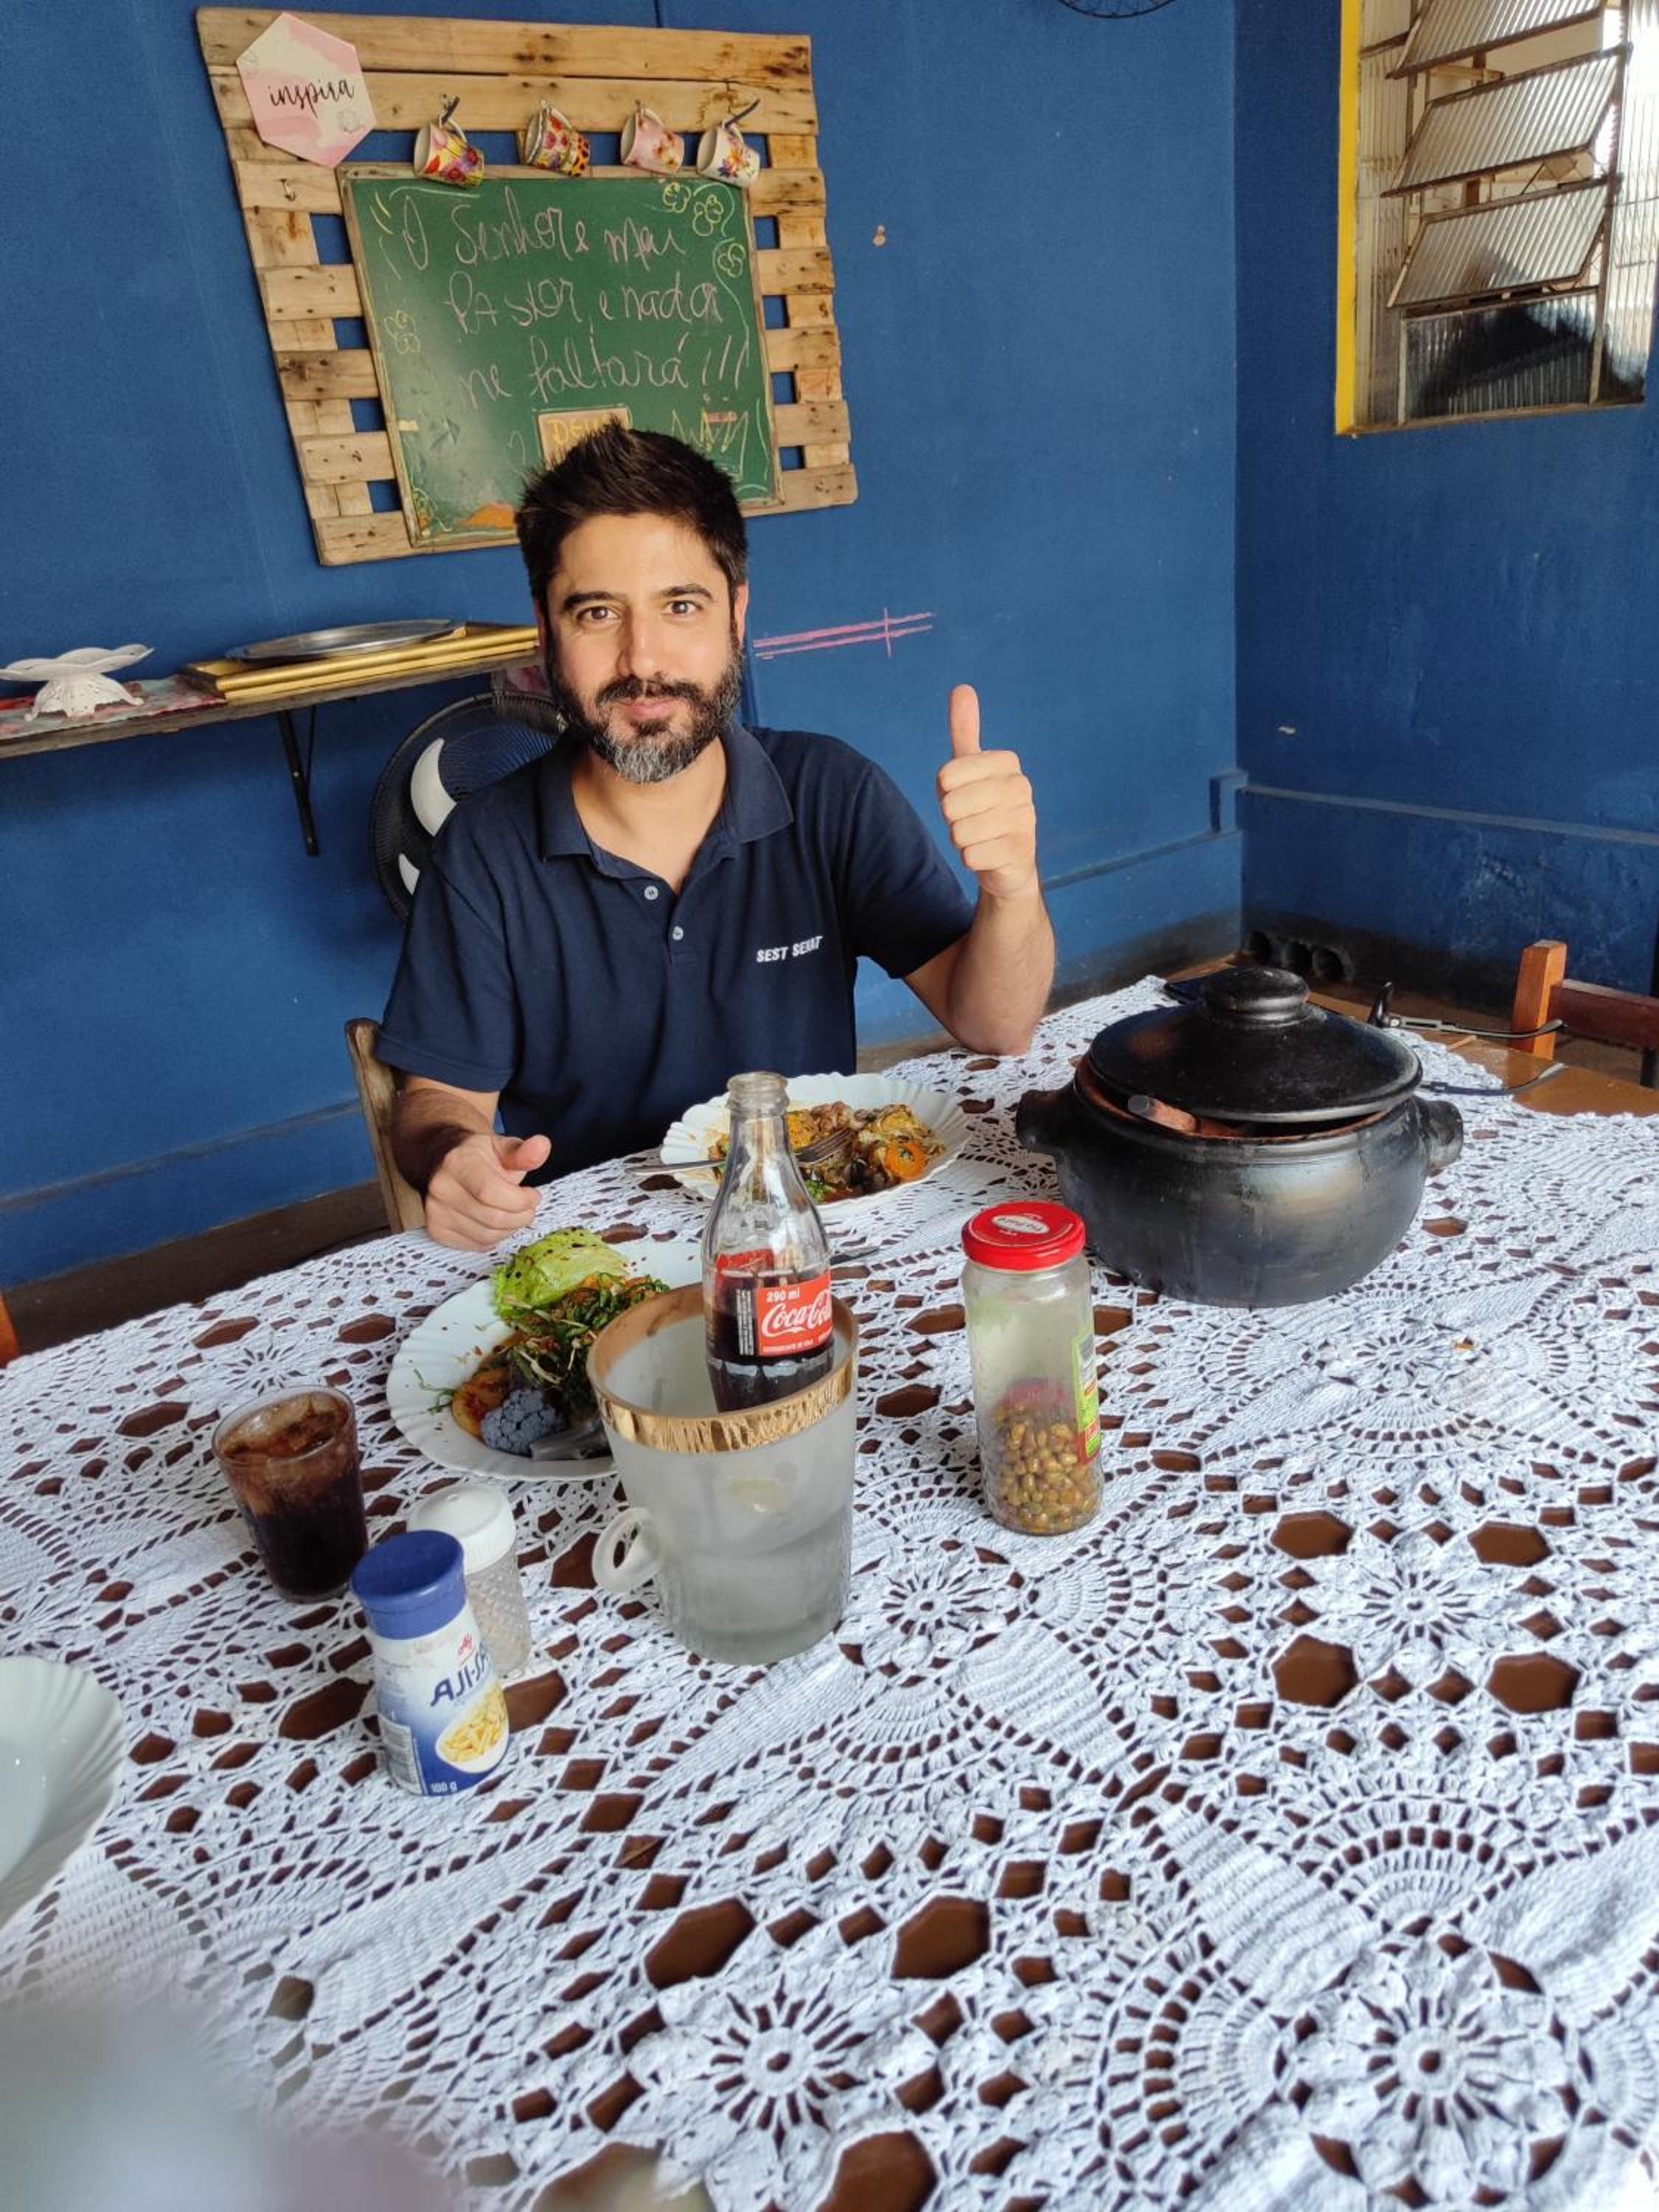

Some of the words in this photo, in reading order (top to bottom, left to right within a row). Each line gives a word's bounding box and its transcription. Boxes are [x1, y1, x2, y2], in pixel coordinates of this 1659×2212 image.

[268, 79, 355, 119] inspira
[757, 946, 789, 963] SEST
[766, 1290, 786, 1303] 290
[787, 1288, 801, 1299] ml
